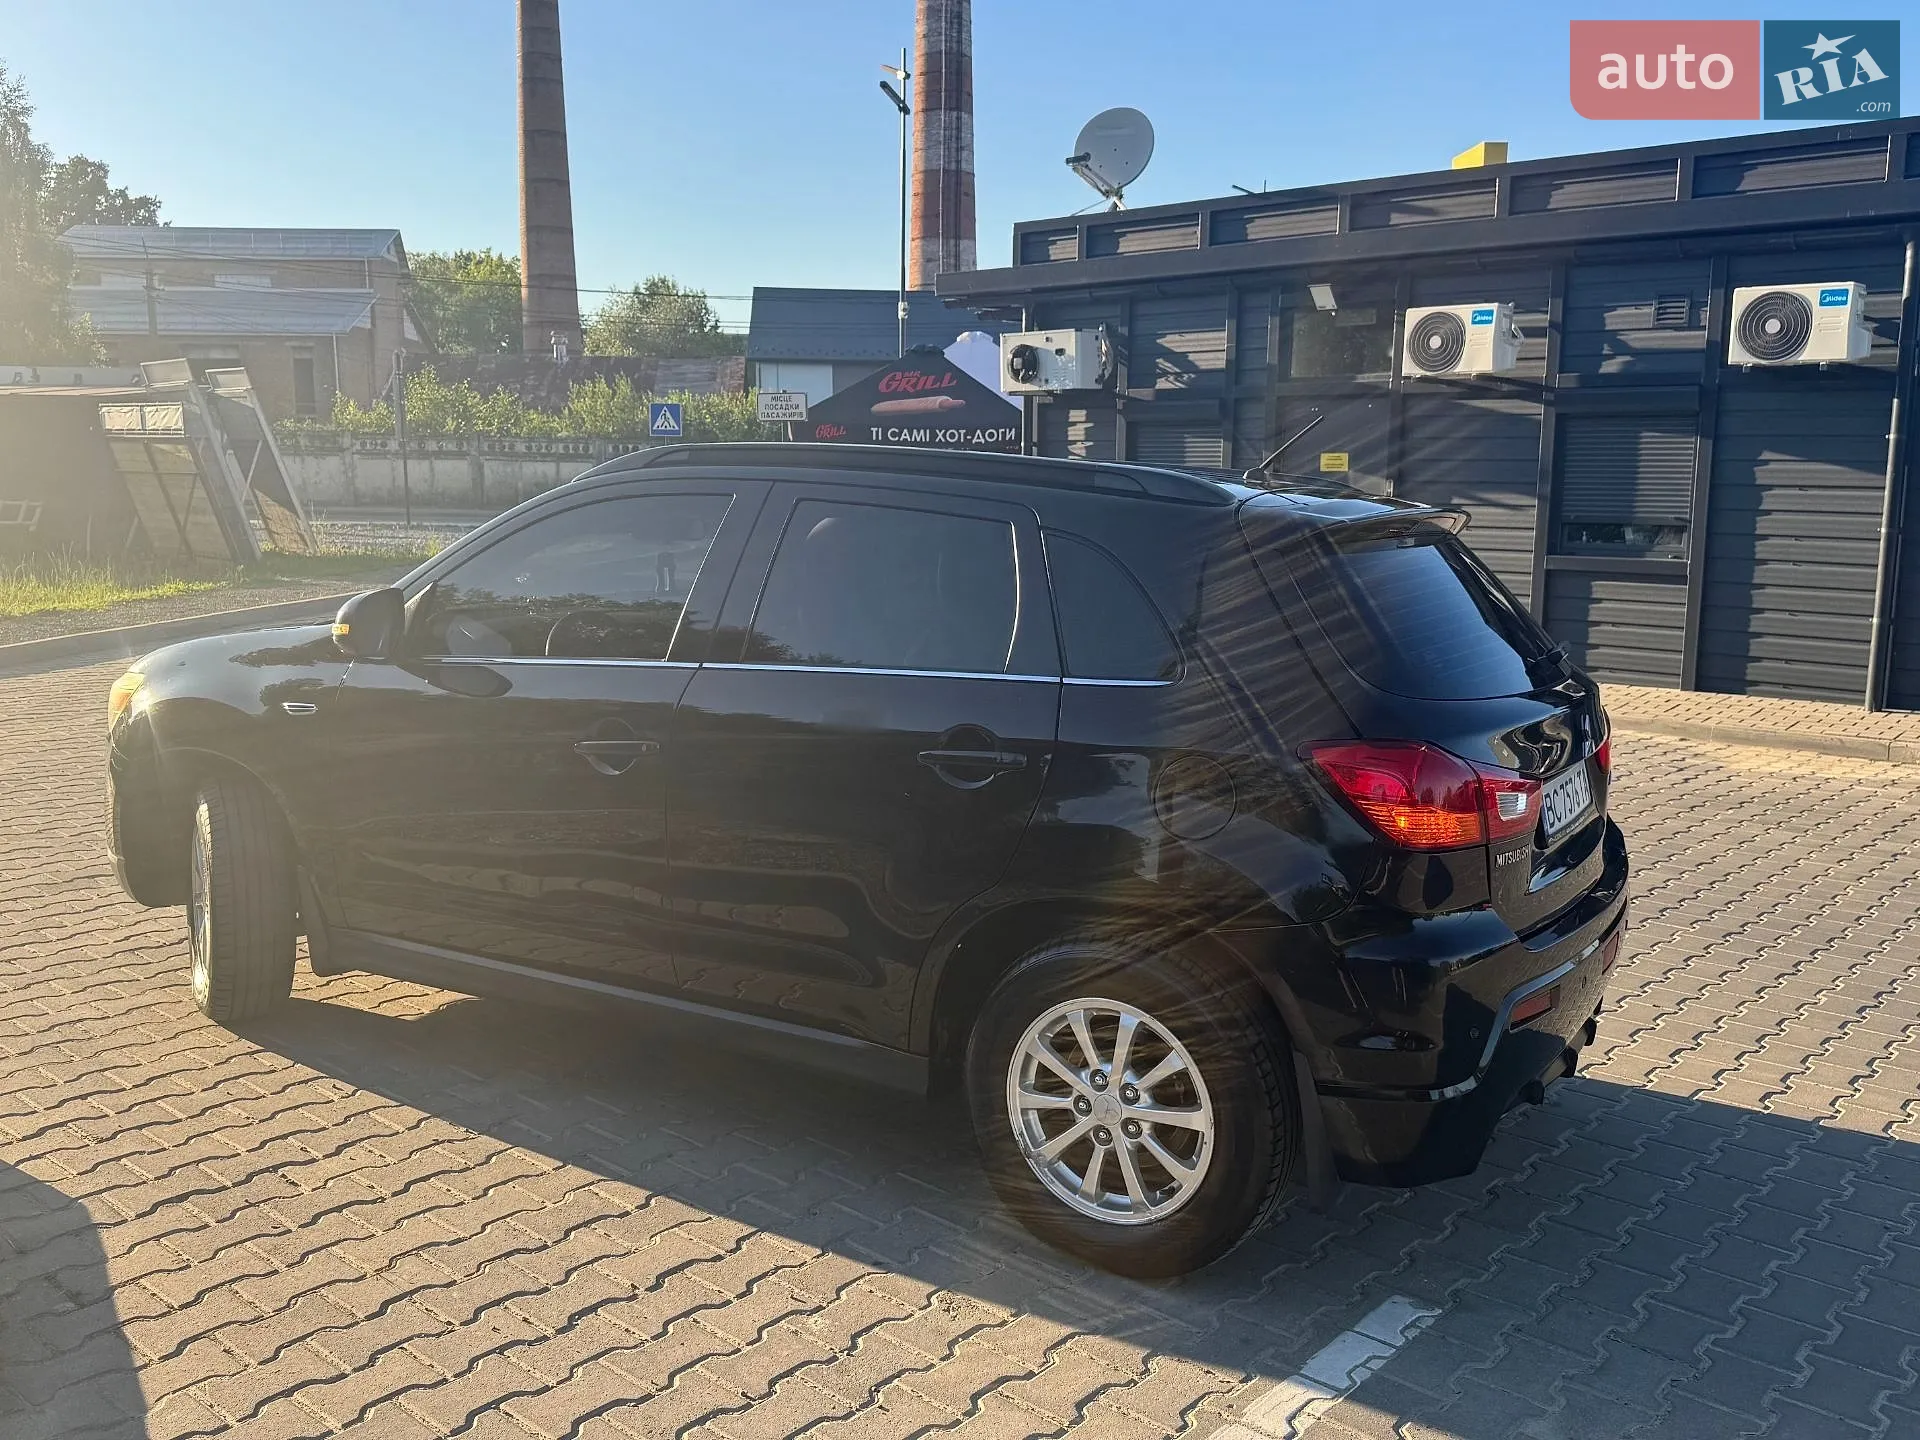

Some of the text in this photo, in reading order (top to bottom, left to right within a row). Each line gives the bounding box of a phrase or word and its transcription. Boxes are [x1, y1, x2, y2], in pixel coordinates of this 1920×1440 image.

[878, 372, 957, 393] GRILL
[764, 403, 800, 411] ПОСАДКИ
[870, 427, 1016, 444] ТІ САМІ ХОТ-ДОГИ
